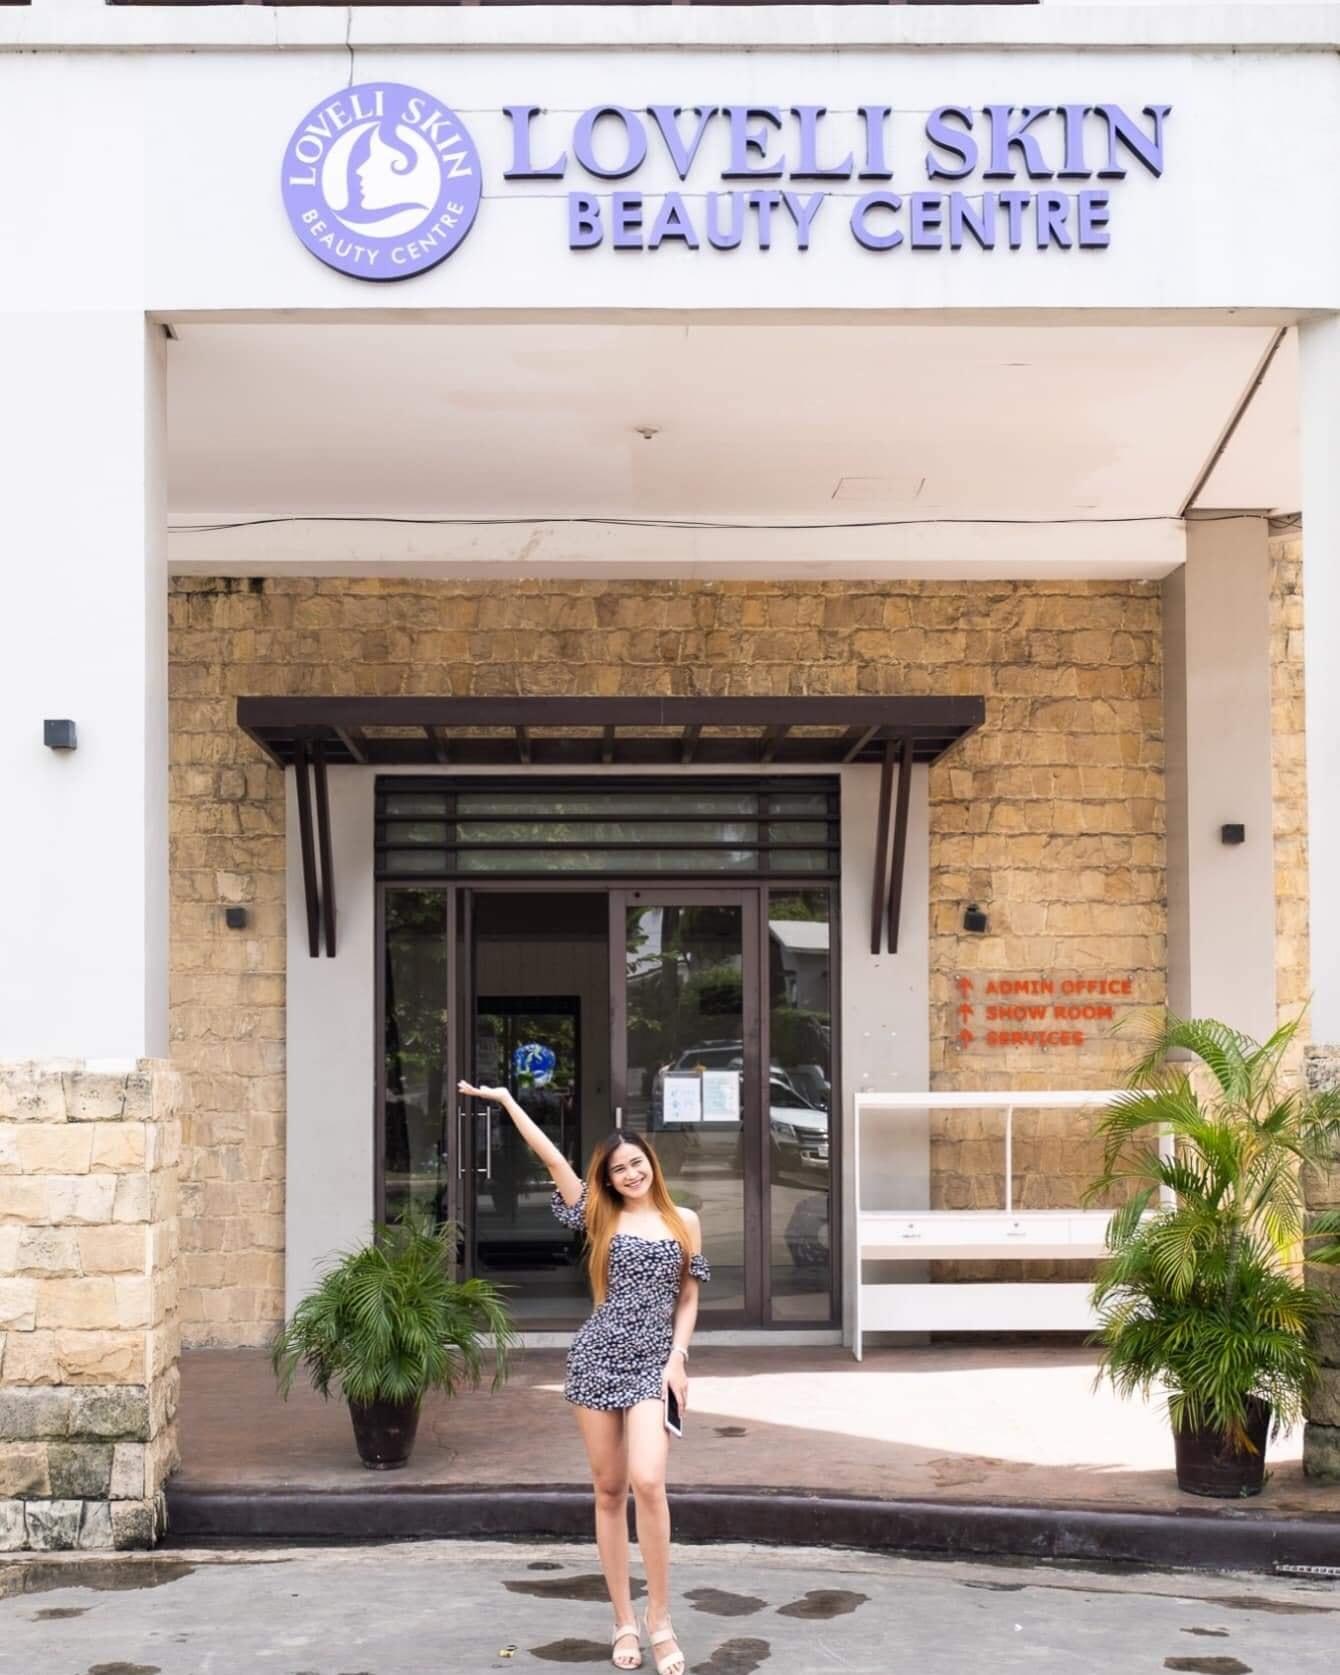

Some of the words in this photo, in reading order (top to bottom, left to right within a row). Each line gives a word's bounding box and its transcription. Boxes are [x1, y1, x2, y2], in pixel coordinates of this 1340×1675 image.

[289, 91, 384, 187] LOVELI
[401, 98, 473, 180] SKIN
[503, 105, 892, 181] LOVELI
[925, 104, 1172, 180] SKIN
[302, 208, 380, 265] BEAUTY
[391, 201, 465, 265] CENTRE
[569, 191, 824, 251] BEAUTY
[850, 191, 1110, 251] CENTRE
[985, 980, 1054, 995] ADMIN
[1061, 980, 1132, 995] OFFICE
[985, 1005, 1048, 1021] SHOW
[1053, 1006, 1114, 1020] ROOM
[985, 1031, 1084, 1046] SERVICES
